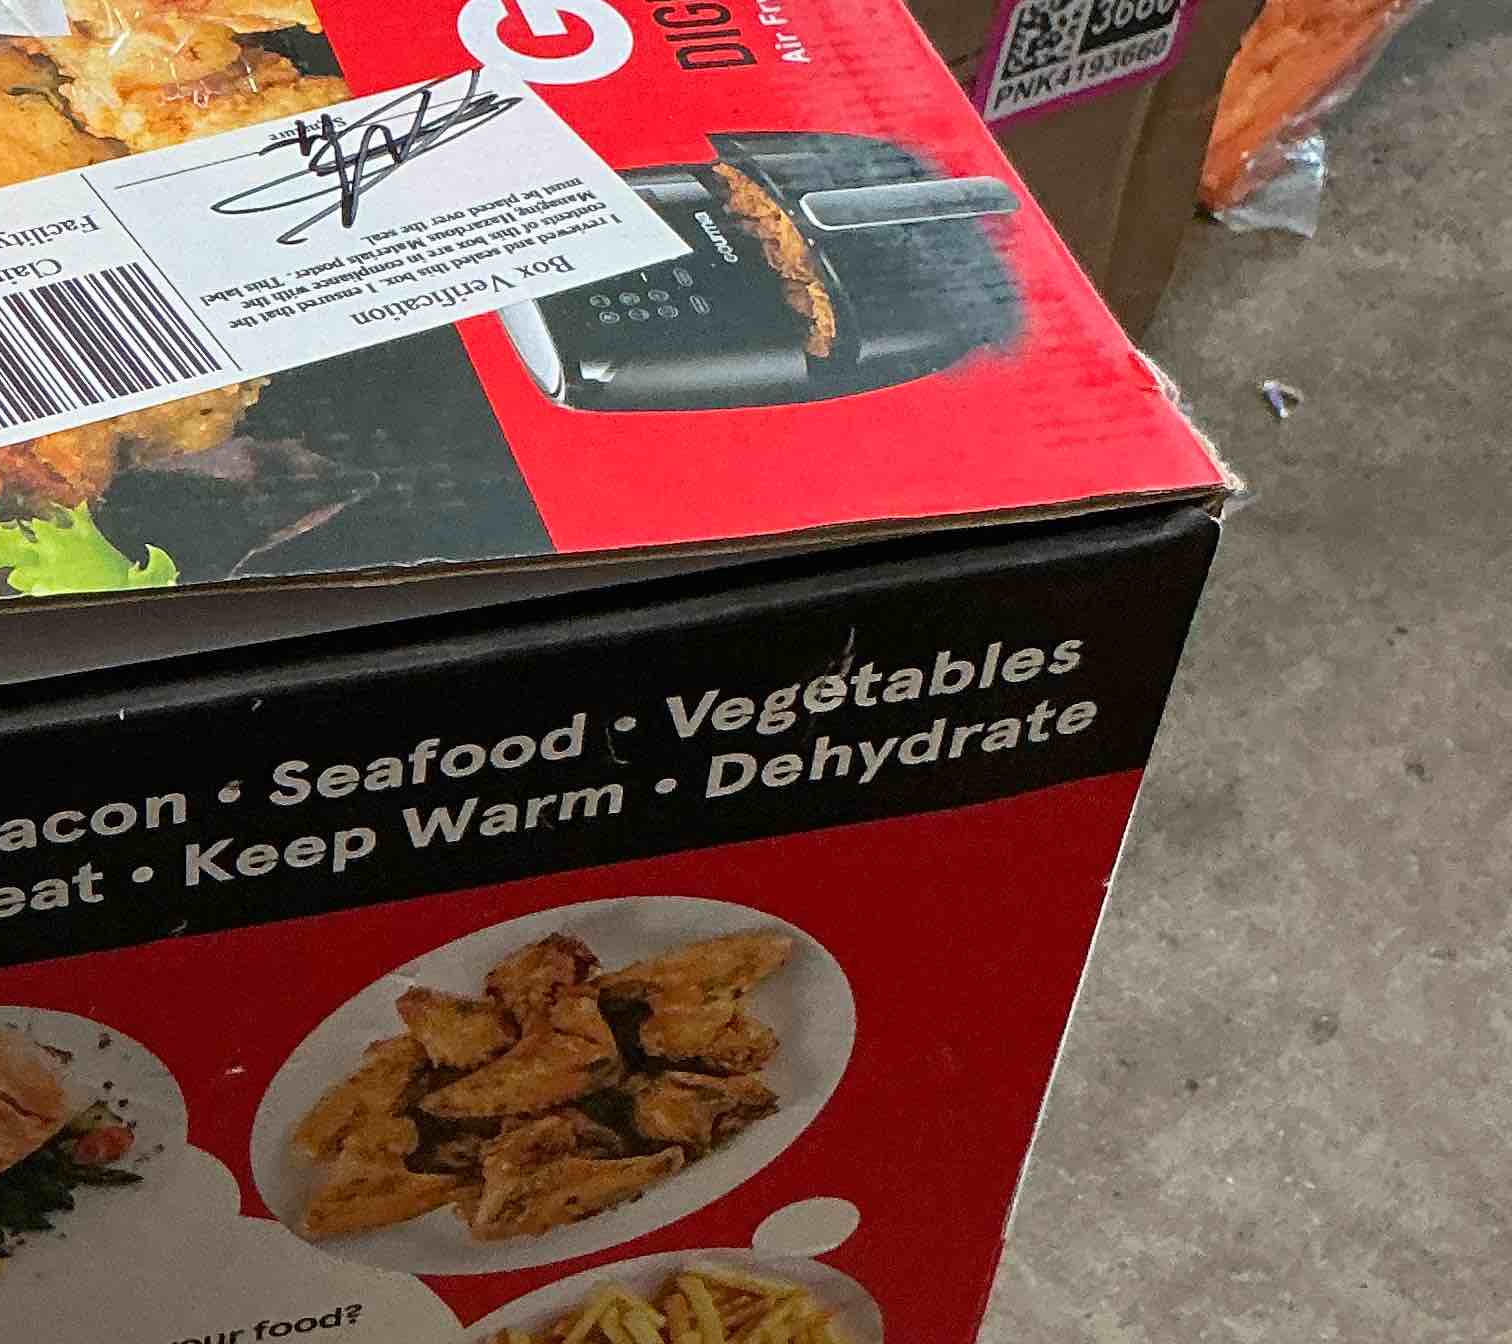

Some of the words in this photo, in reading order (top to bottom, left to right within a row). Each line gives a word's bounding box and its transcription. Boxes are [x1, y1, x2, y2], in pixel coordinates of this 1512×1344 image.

[776, 33, 810, 64] Air
[994, 31, 1169, 112] PNK4193660
[521, 189, 544, 200] be
[541, 177, 584, 196] must
[467, 193, 521, 218] placed
[513, 190, 597, 216] Managing
[431, 210, 466, 226] over
[540, 202, 607, 226] contents
[399, 221, 428, 234] the
[426, 212, 517, 242] Hazardous
[487, 226, 522, 241] this
[520, 221, 539, 234] of
[536, 217, 608, 245] reviewed
[360, 229, 399, 246] seal.
[455, 236, 489, 249] box
[502, 238, 536, 255] and
[346, 237, 427, 265] Materials
[406, 253, 426, 264] in
[426, 245, 455, 258] are
[449, 247, 502, 270] sealed
[287, 257, 346, 279] poster.
[312, 259, 404, 290] compliance
[416, 263, 451, 277] this
[514, 255, 576, 279] Box
[243, 276, 286, 293] This
[379, 272, 418, 286] box.
[199, 287, 244, 307] label
[240, 296, 271, 309] the
[270, 286, 311, 302] with
[296, 286, 363, 313] ensured
[350, 275, 515, 325] Verification
[229, 316, 259, 329] the
[258, 305, 296, 322] that
[271, 714, 585, 805] Seafood
[668, 641, 1080, 737] Vegetables
[185, 827, 376, 885] Keep
[403, 784, 623, 847] Warm
[707, 701, 1096, 797] Dehydrate
[254, 1304, 362, 1341] food?
